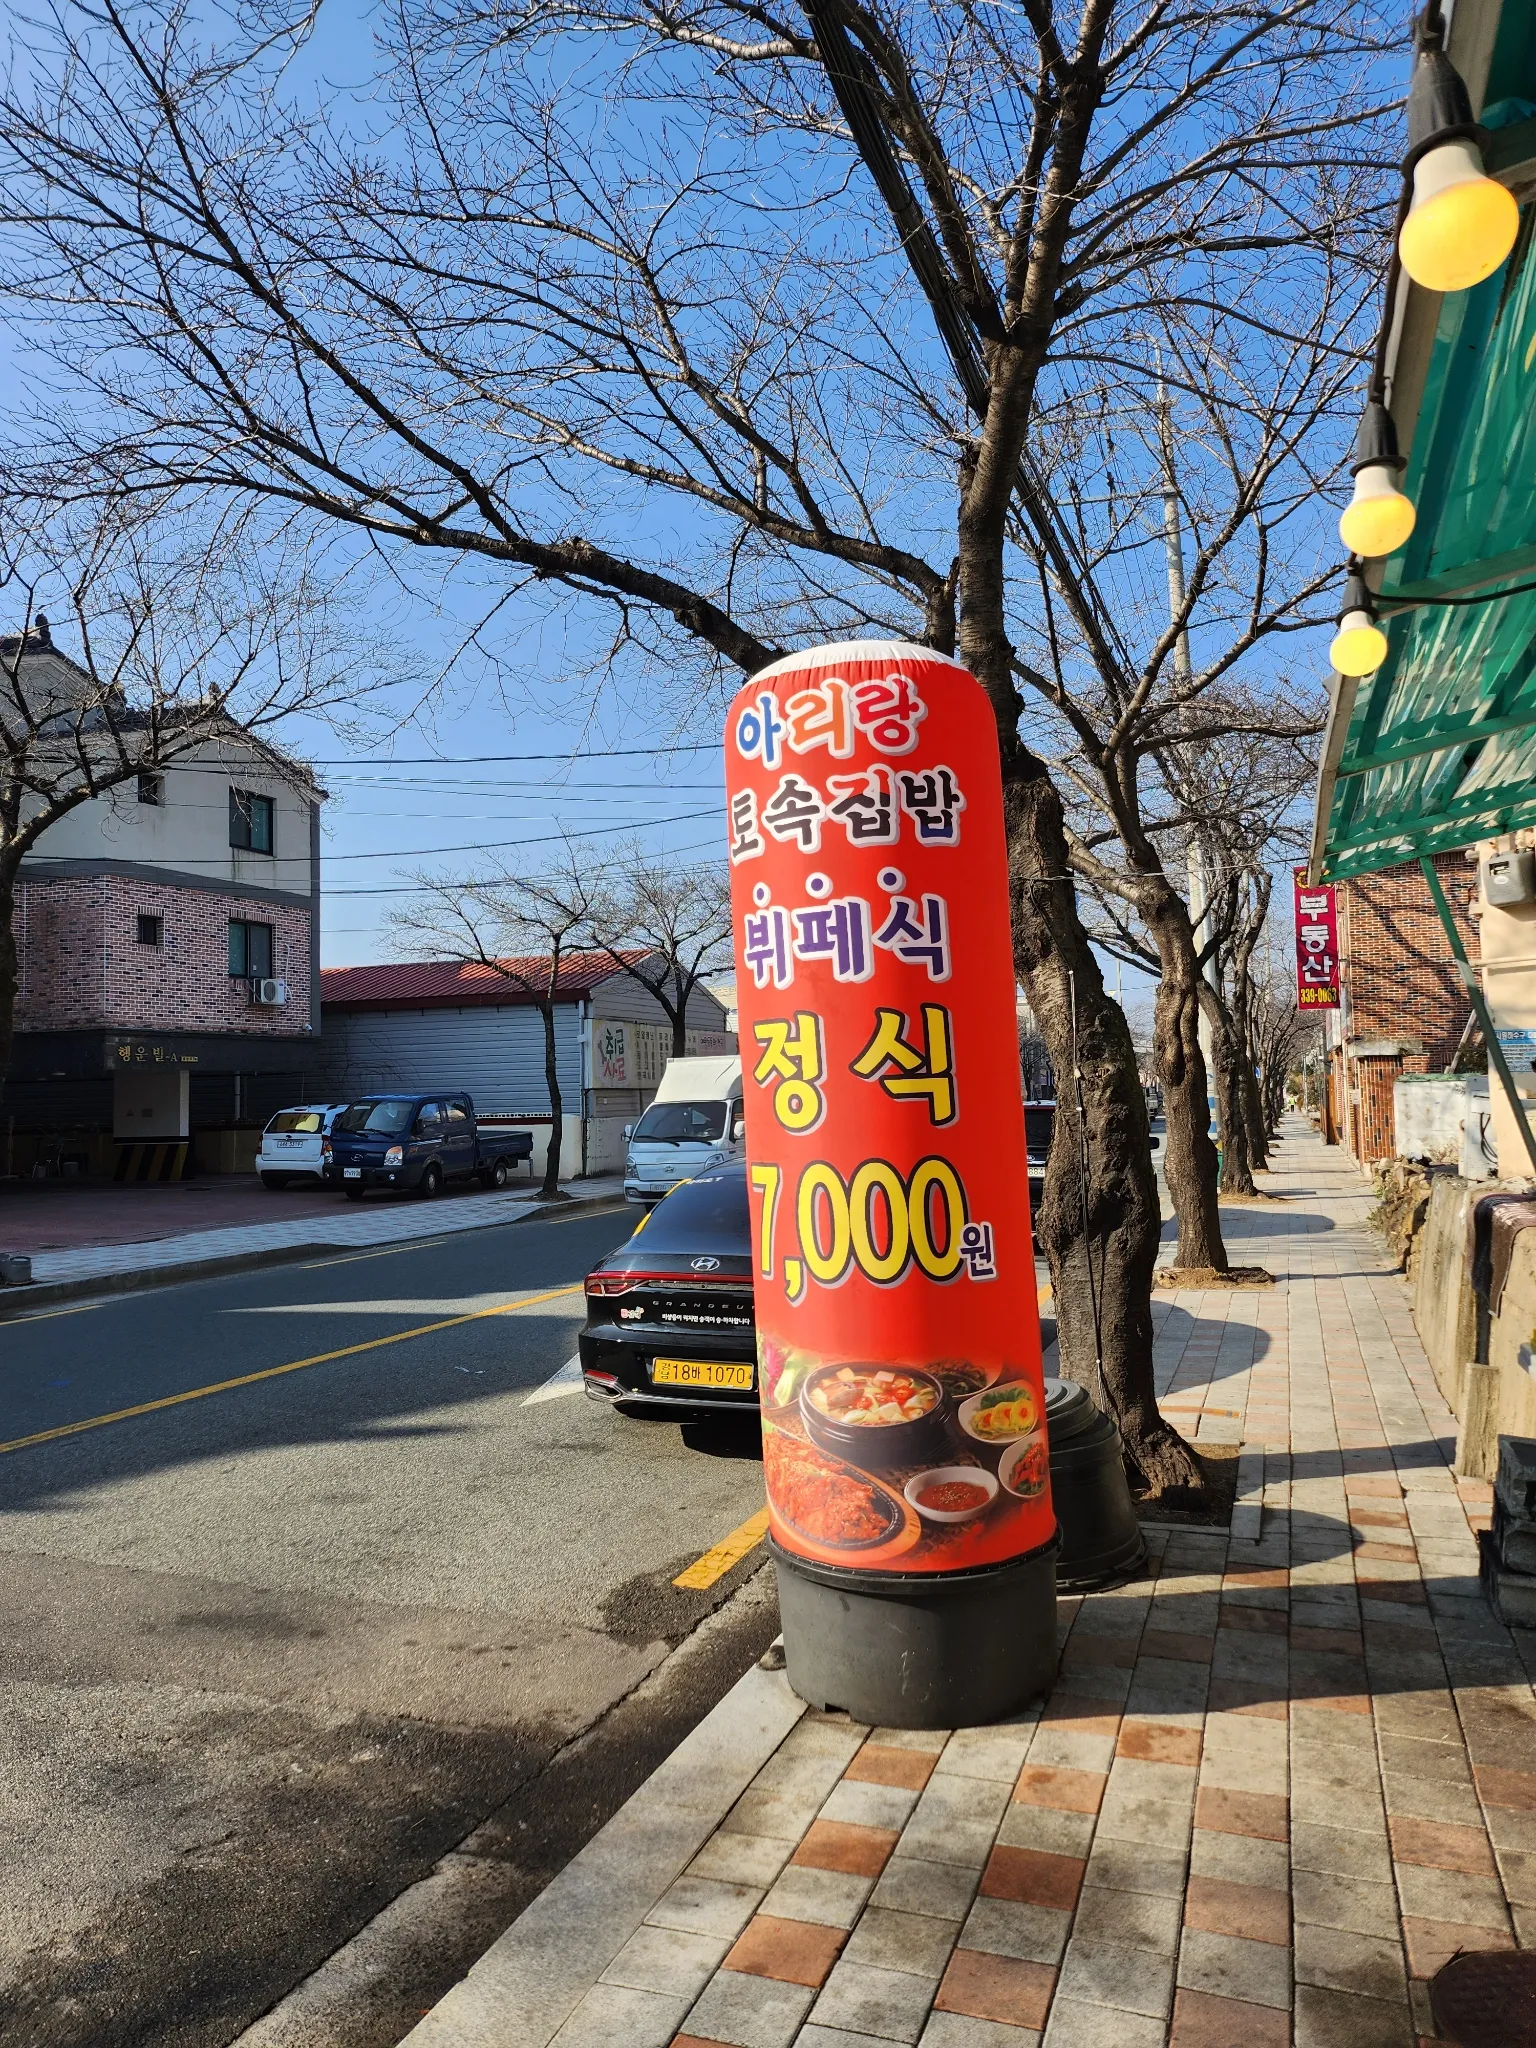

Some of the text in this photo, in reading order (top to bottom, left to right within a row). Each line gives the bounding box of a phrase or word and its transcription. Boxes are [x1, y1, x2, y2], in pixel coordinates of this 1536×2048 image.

[736, 673, 928, 769] 아리랑
[730, 763, 968, 867] 토속집밥
[744, 891, 952, 990] 뷔페식
[1300, 895, 1333, 983] 부동산
[603, 1057, 627, 1082] 사료
[653, 1300, 755, 1310] GRANDEU
[706, 1365, 745, 1384] 1070
